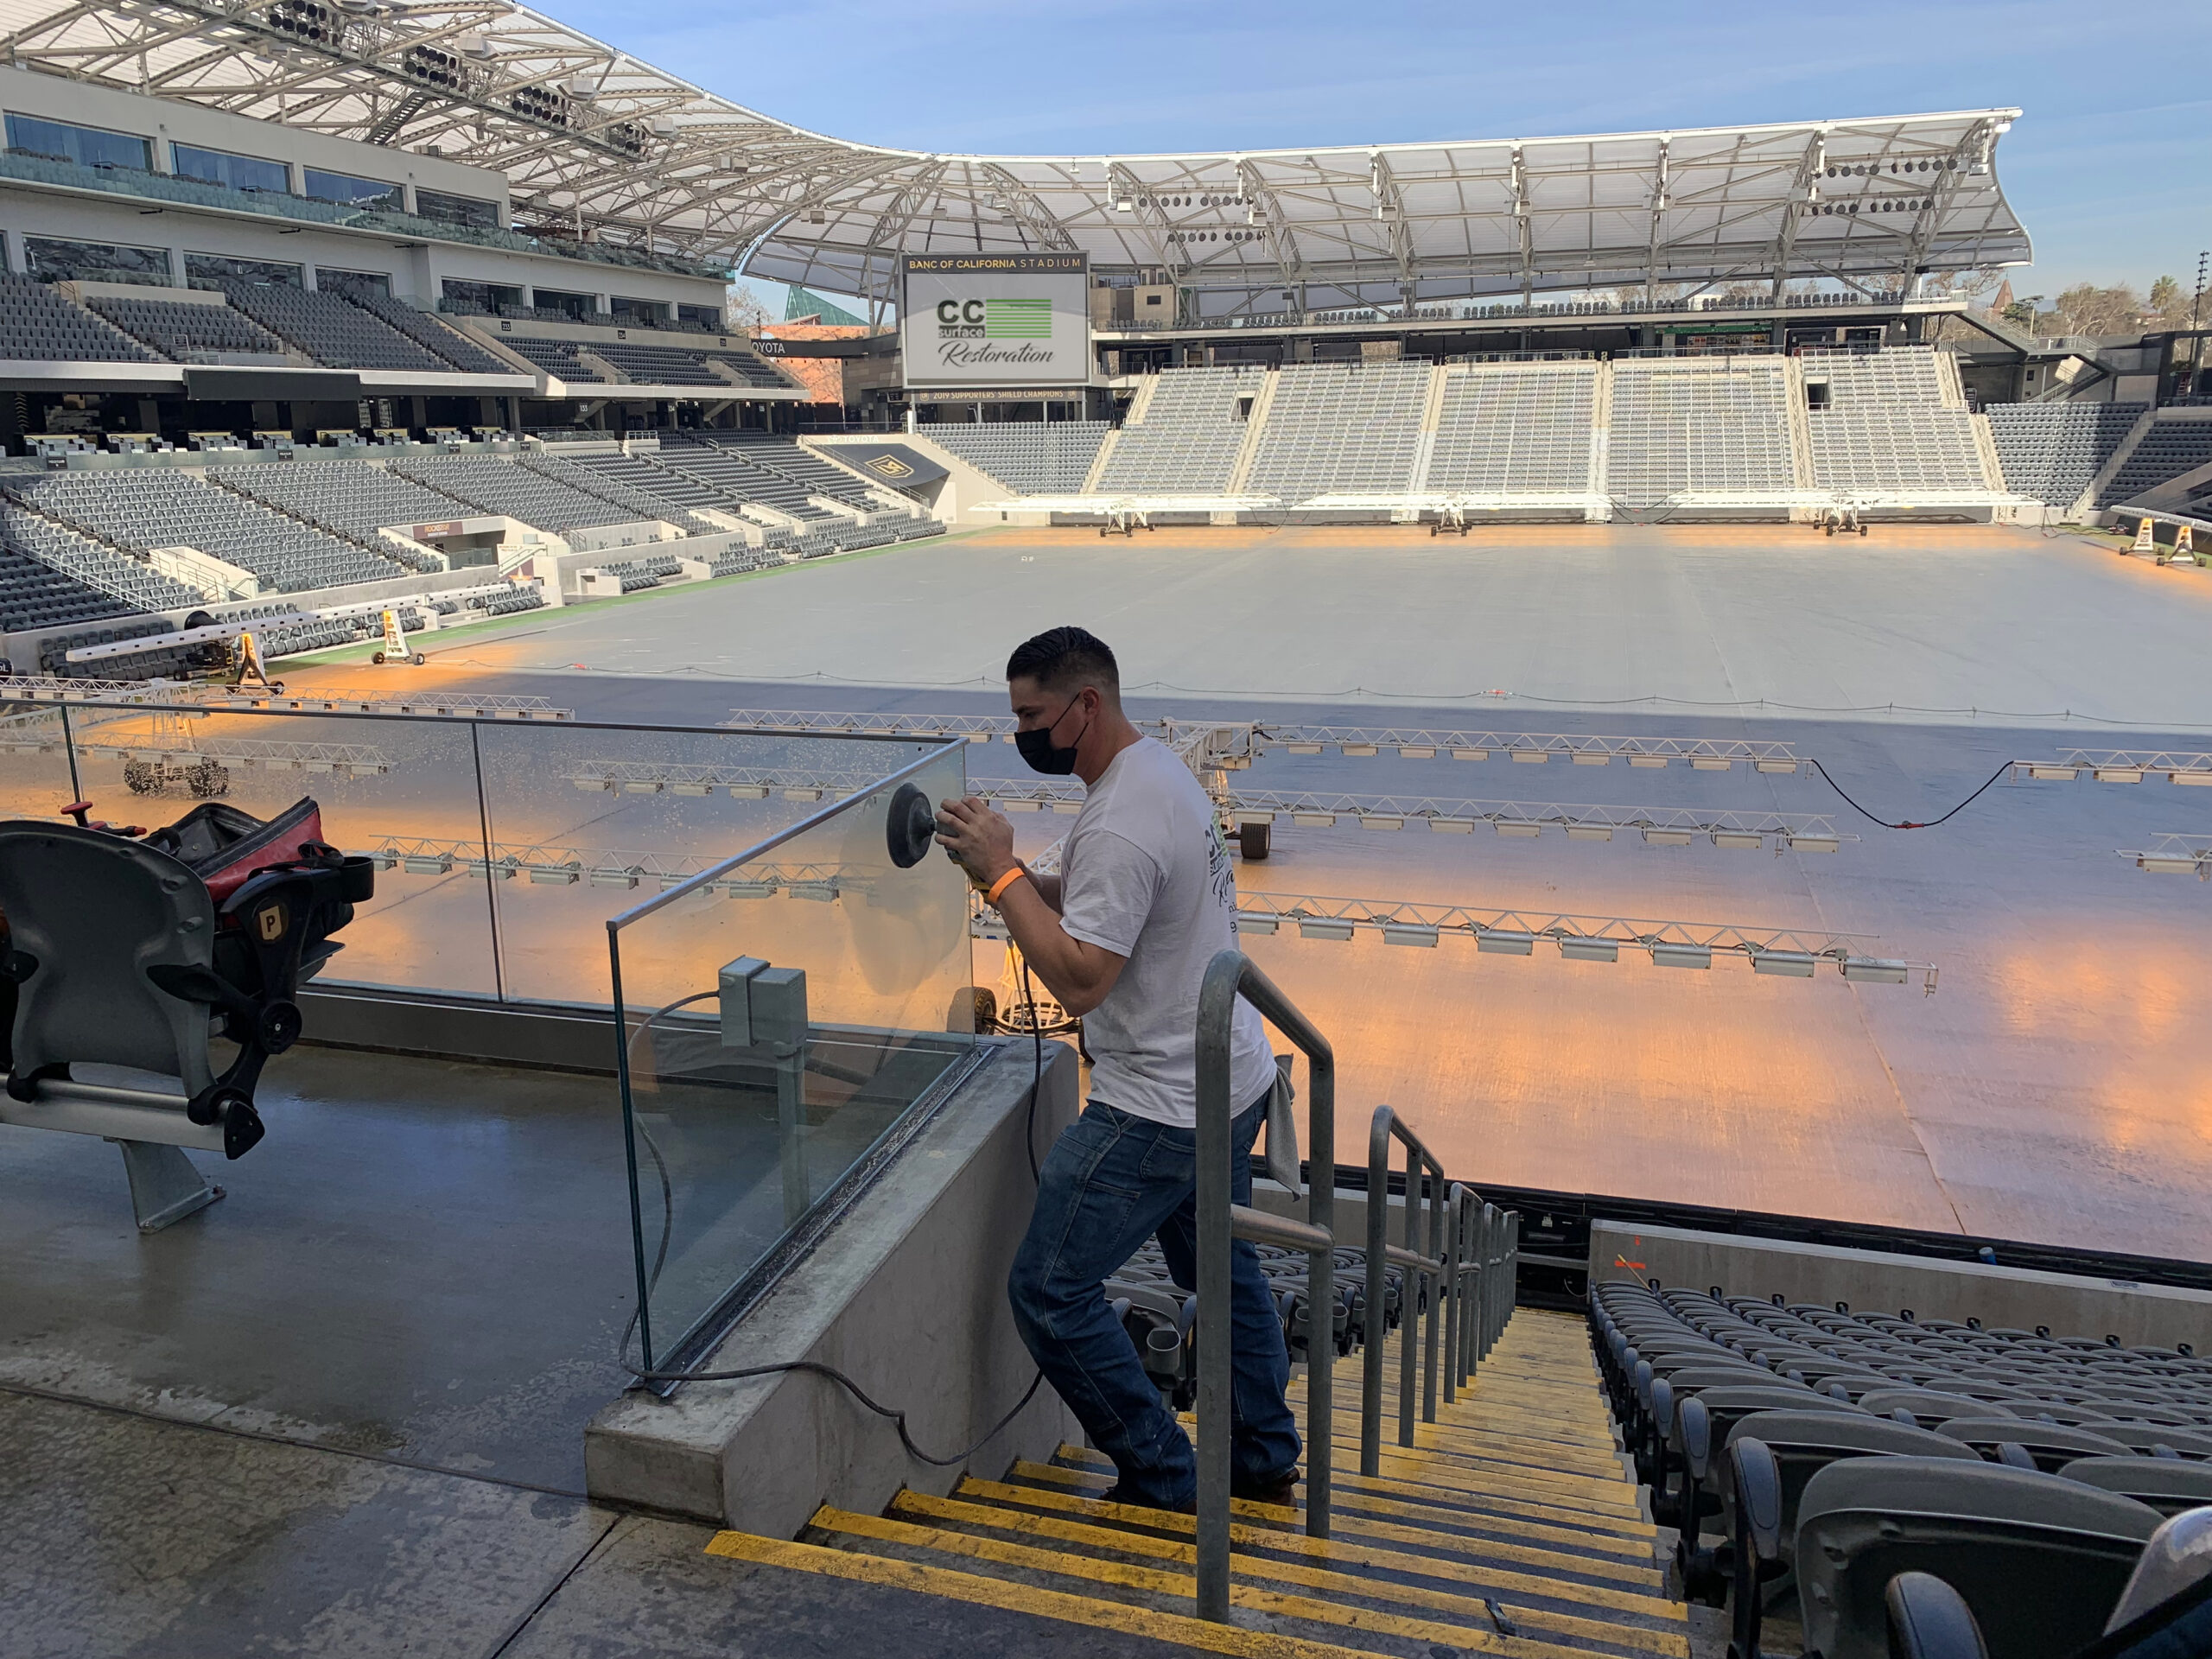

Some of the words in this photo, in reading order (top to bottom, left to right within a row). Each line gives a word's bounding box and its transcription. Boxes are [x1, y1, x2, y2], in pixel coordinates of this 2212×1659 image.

[909, 260, 938, 270] BANC
[940, 260, 954, 269] OF
[956, 259, 1017, 269] CALIFORNIA
[1020, 258, 1081, 268] STADIUM
[937, 299, 985, 324] CC
[938, 326, 985, 338] surface
[752, 341, 785, 353] OYOTA
[938, 340, 1055, 368] Restoration
[266, 915, 276, 932] P
